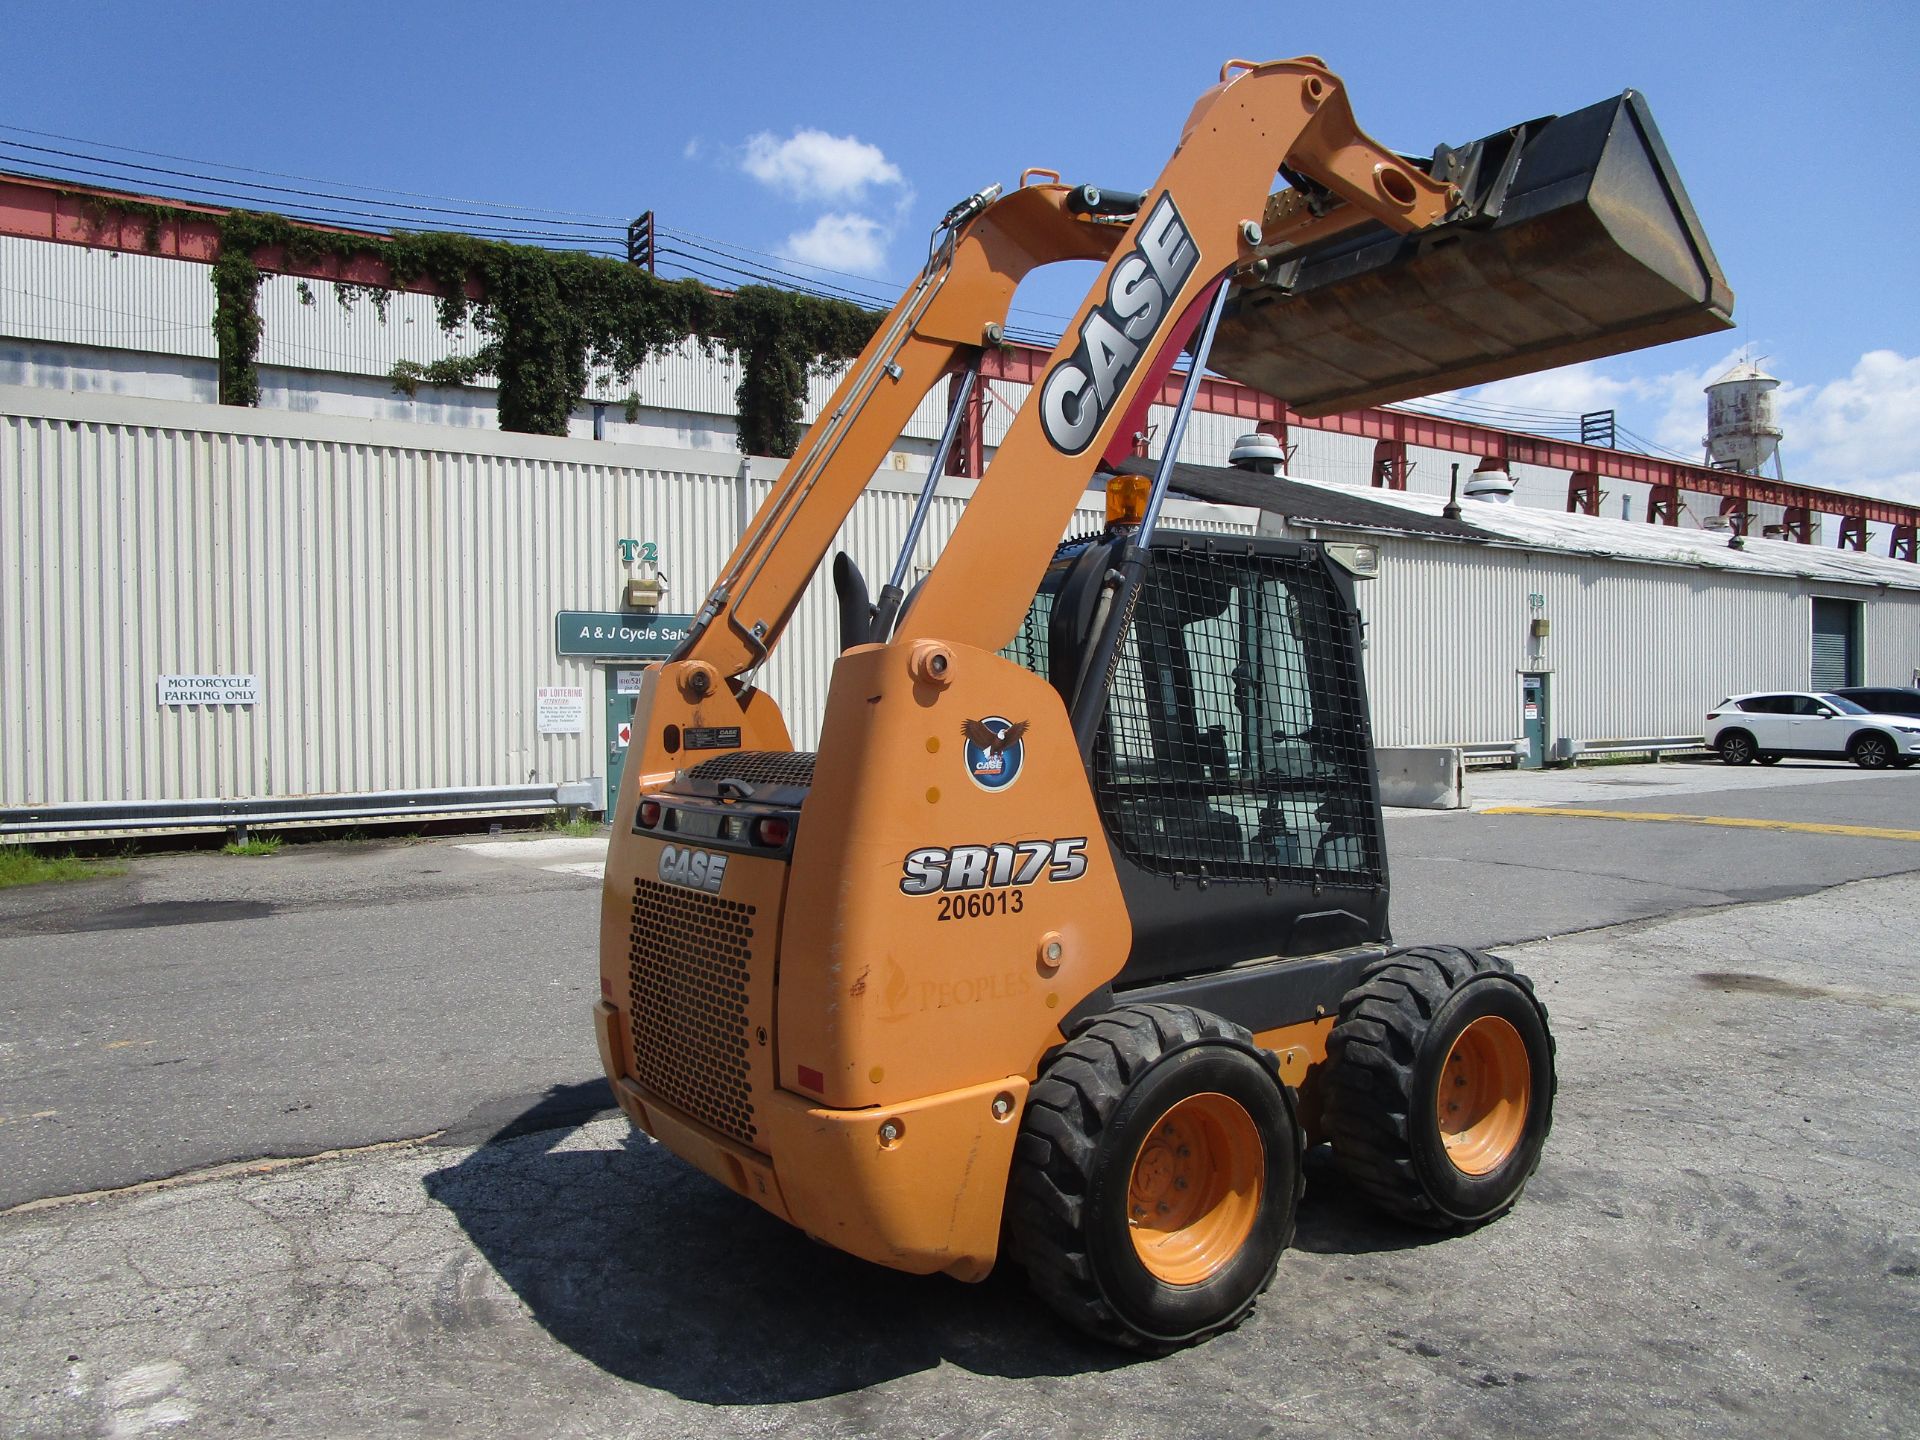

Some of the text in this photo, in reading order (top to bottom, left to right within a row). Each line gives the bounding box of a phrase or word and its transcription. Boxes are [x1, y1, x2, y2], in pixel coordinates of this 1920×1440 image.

[1040, 191, 1201, 455] CASE
[618, 538, 658, 562] T2
[579, 626, 590, 639] A
[594, 626, 604, 639] &
[607, 627, 616, 639] J
[619, 627, 657, 642] Cycle
[168, 678, 251, 688] MOTORCYCLE
[538, 688, 583, 698] NO LOITERING
[165, 690, 256, 701] PARKING ONLY
[975, 759, 1003, 770] CASE
[658, 845, 728, 893] CASE
[900, 837, 1088, 895] SR175
[937, 890, 1024, 921] 206013
